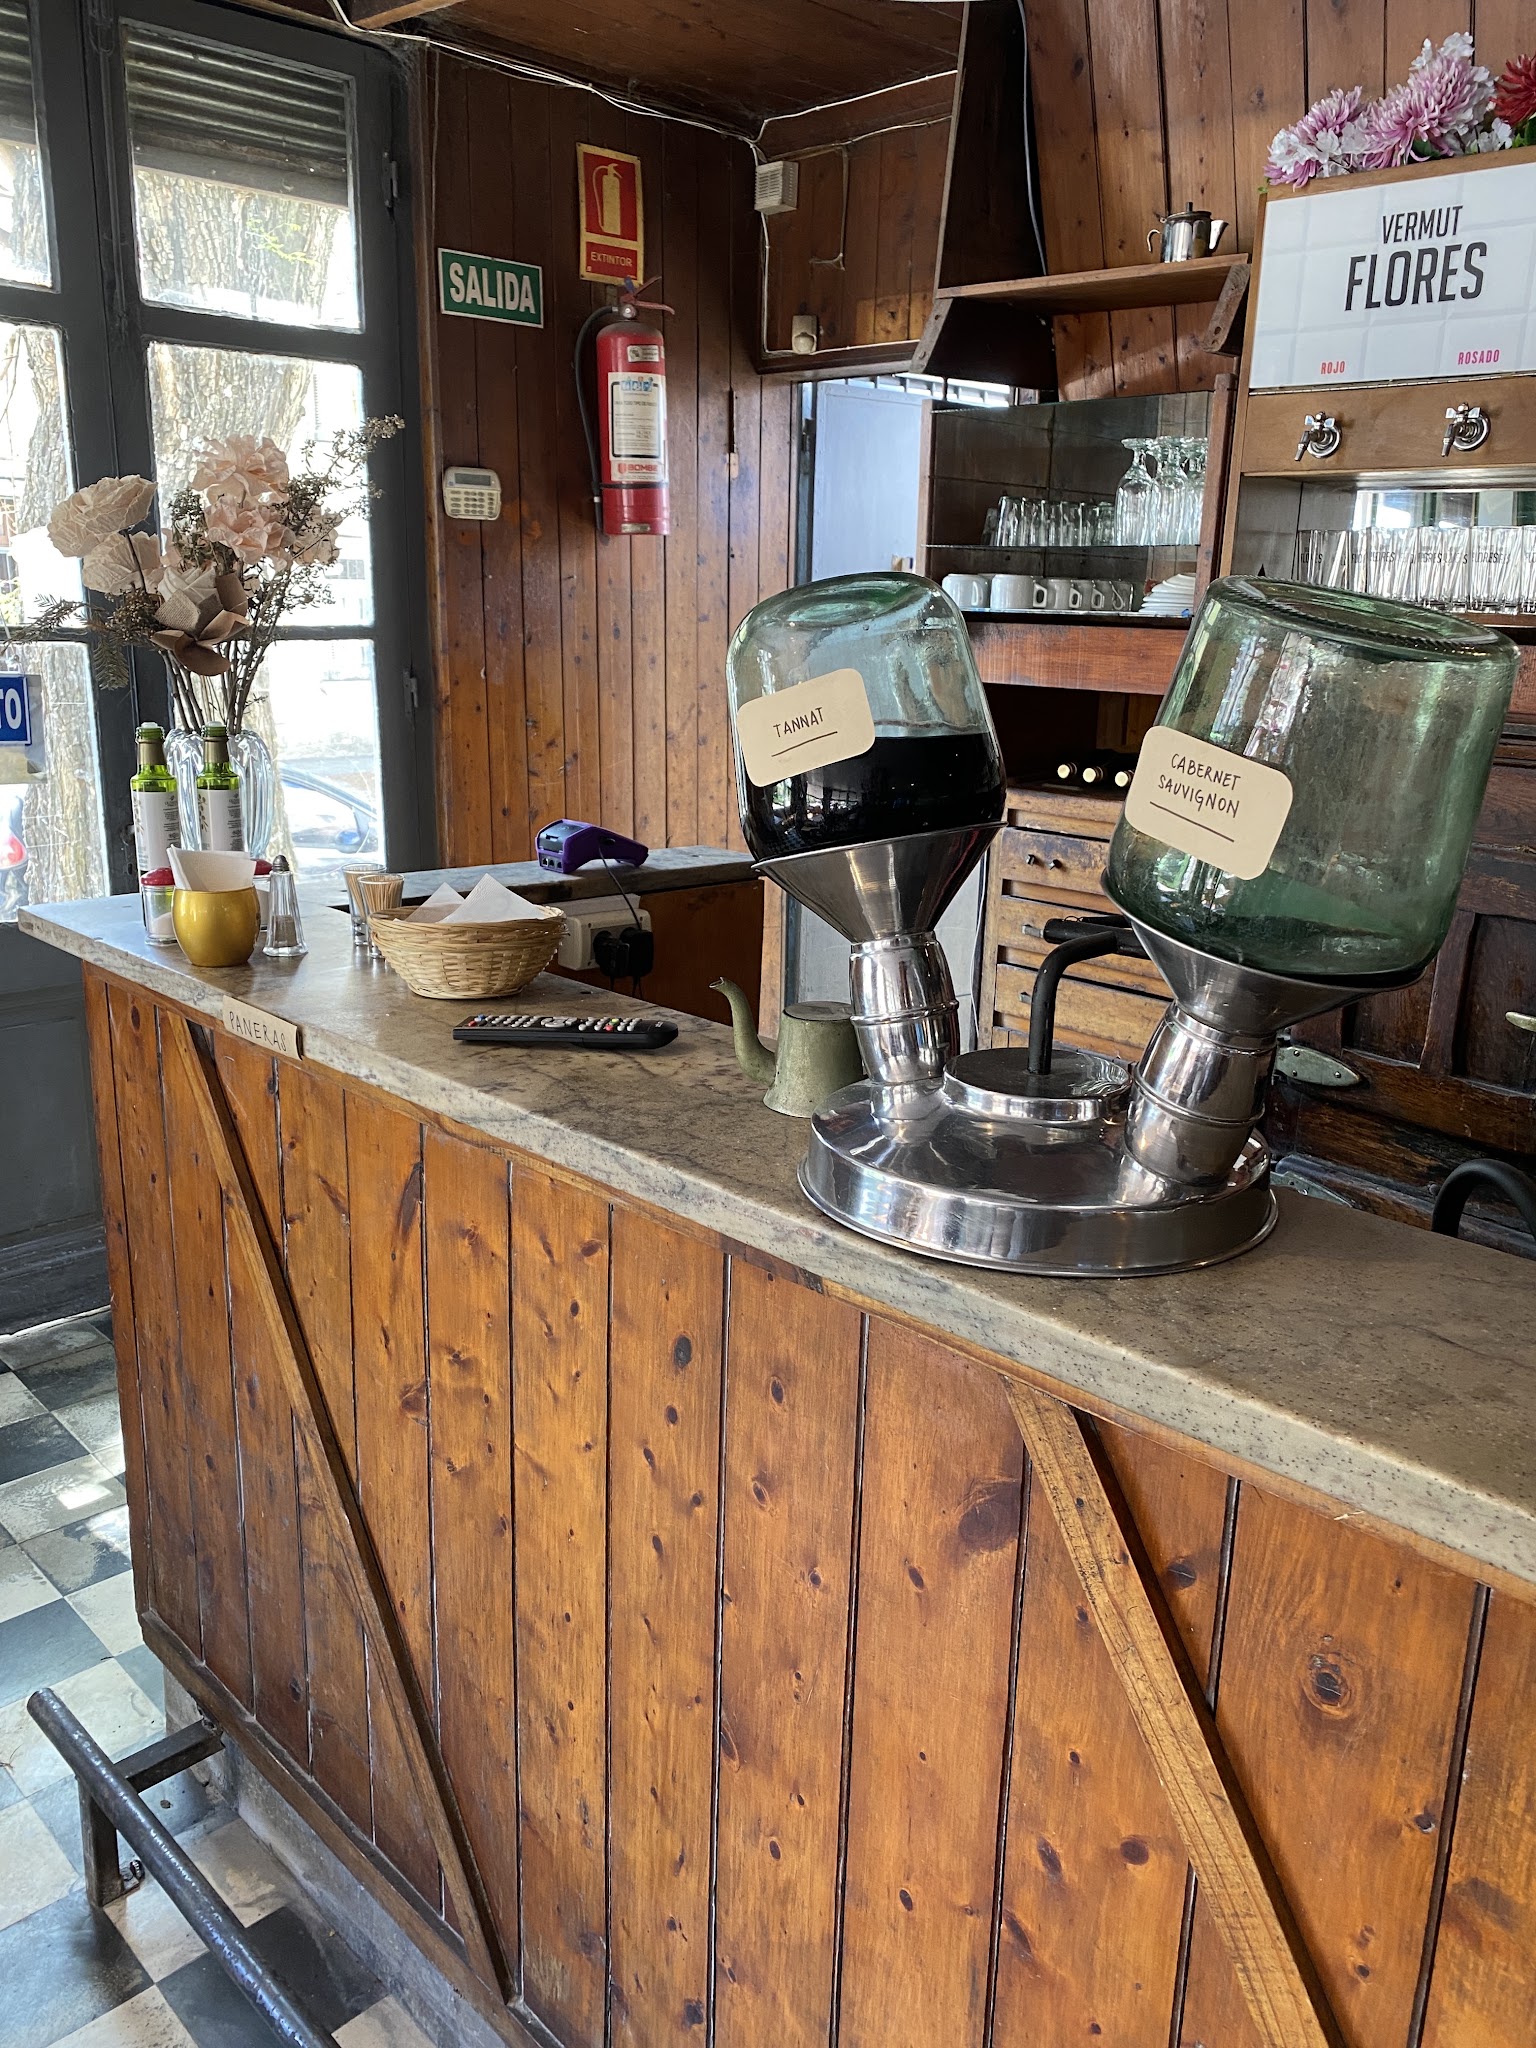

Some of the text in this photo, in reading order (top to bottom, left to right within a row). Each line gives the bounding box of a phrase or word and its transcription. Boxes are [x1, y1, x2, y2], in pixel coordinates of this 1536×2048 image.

[1382, 205, 1463, 244] VERMUT
[590, 251, 633, 267] EXTINTOR
[1344, 241, 1488, 312] FLORES
[449, 262, 536, 314] SALIDA
[1320, 360, 1346, 375] ROJO
[1457, 349, 1500, 365] ROSADO
[773, 707, 824, 738] TANNAT
[1171, 753, 1241, 791] CABERNET
[1158, 774, 1240, 819] SAUVIGNON
[229, 1011, 287, 1052] PANERAS
